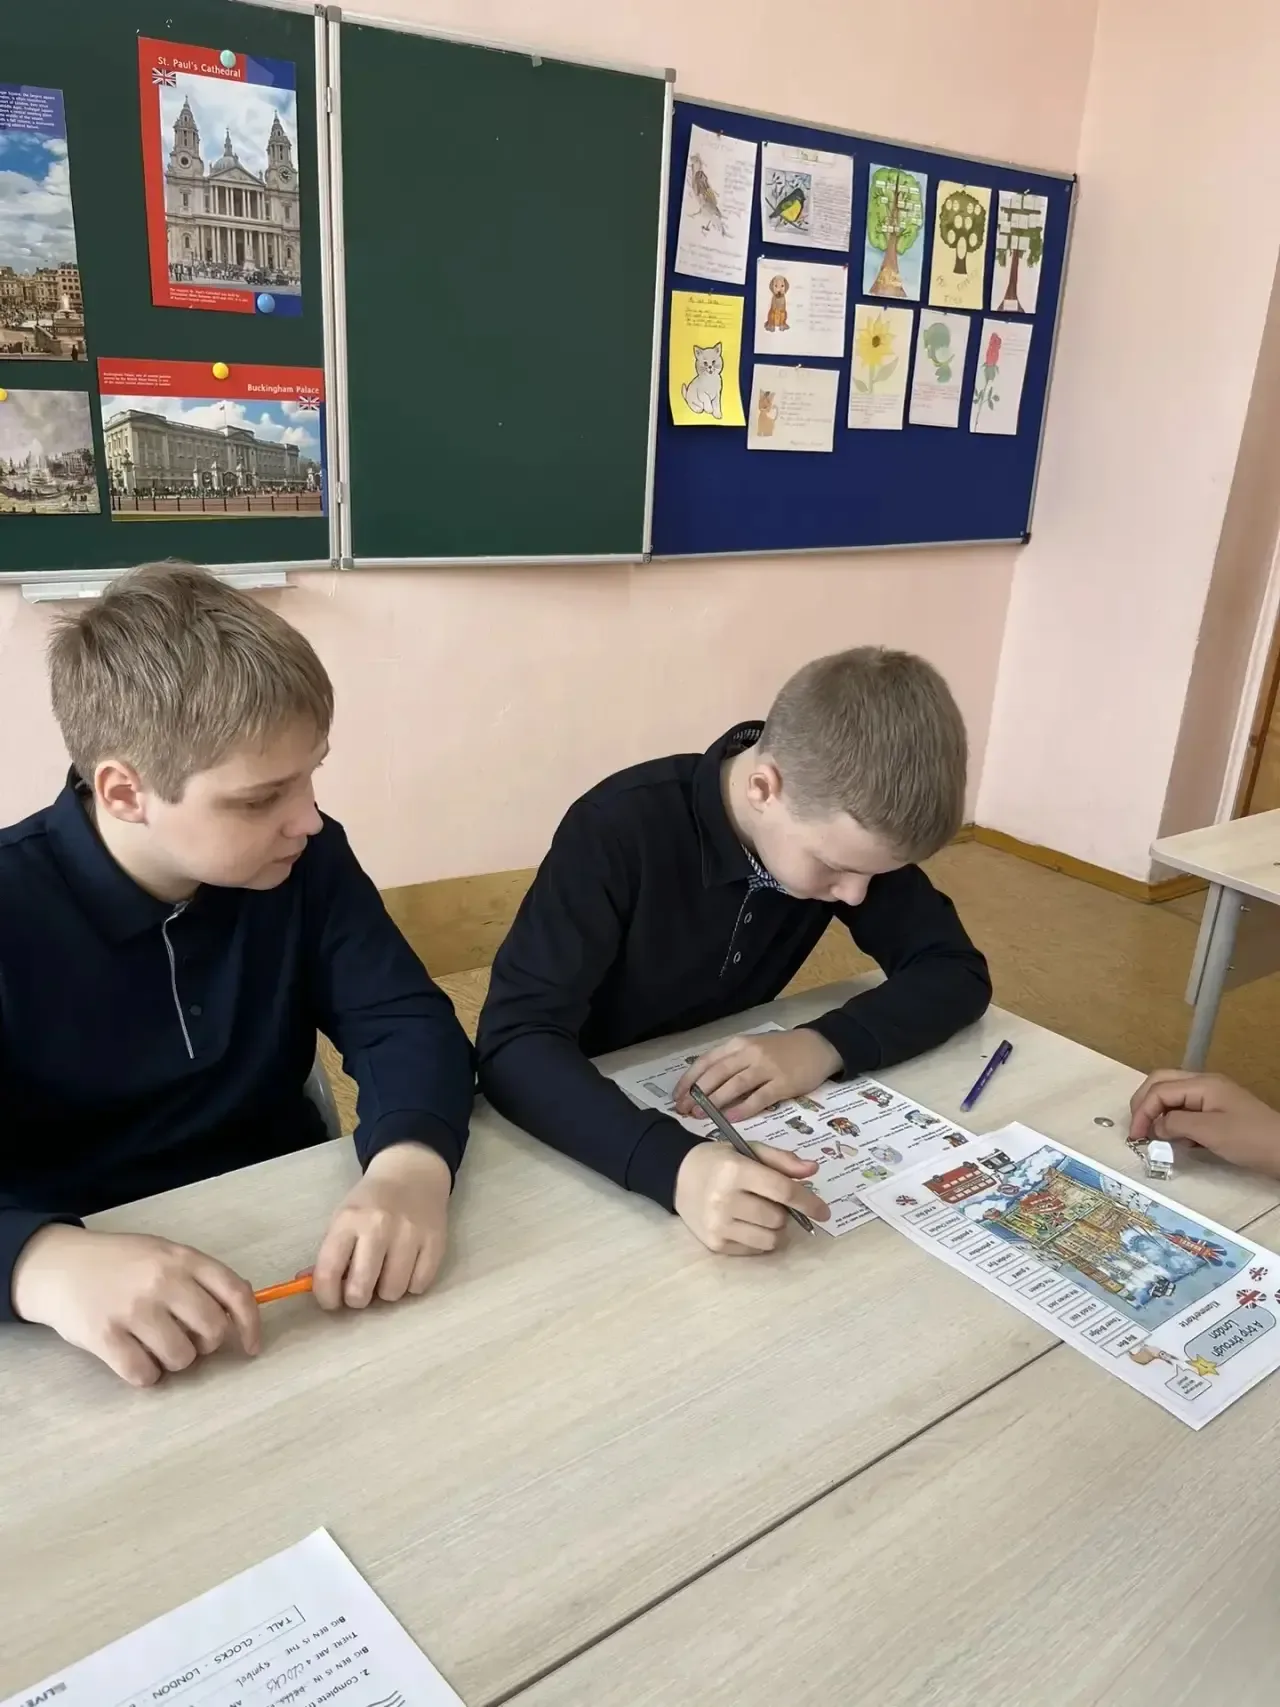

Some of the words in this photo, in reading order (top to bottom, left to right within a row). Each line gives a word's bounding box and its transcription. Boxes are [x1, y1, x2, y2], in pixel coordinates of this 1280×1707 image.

[157, 56, 169, 66] St.
[173, 58, 198, 71] Paul's
[200, 63, 241, 78] Cathedral
[247, 383, 294, 394] Buckingham
[296, 385, 320, 394] Palace
[1178, 1300, 1220, 1328] Klammerkarte
[1207, 1319, 1240, 1339] London
[1251, 1319, 1264, 1329] A
[1238, 1325, 1258, 1338] trip
[1211, 1334, 1244, 1357] through
[266, 1616, 293, 1633] TALL
[330, 1615, 346, 1628] BIG
[312, 1625, 329, 1639] BEN
[302, 1637, 311, 1645] IS
[332, 1631, 358, 1649] THERE
[213, 1638, 253, 1665] CLOCKS
[285, 1643, 300, 1656] THE
[315, 1647, 330, 1661] ARE
[353, 1646, 369, 1659] BIG
[335, 1656, 352, 1670] BEN
[236, 1661, 270, 1687] symbol
[313, 1674, 324, 1684] IN
[325, 1668, 334, 1676] IS
[359, 1668, 371, 1677] 2.
[152, 1667, 201, 1700] LONDON
[317, 1675, 359, 1704] Complete
